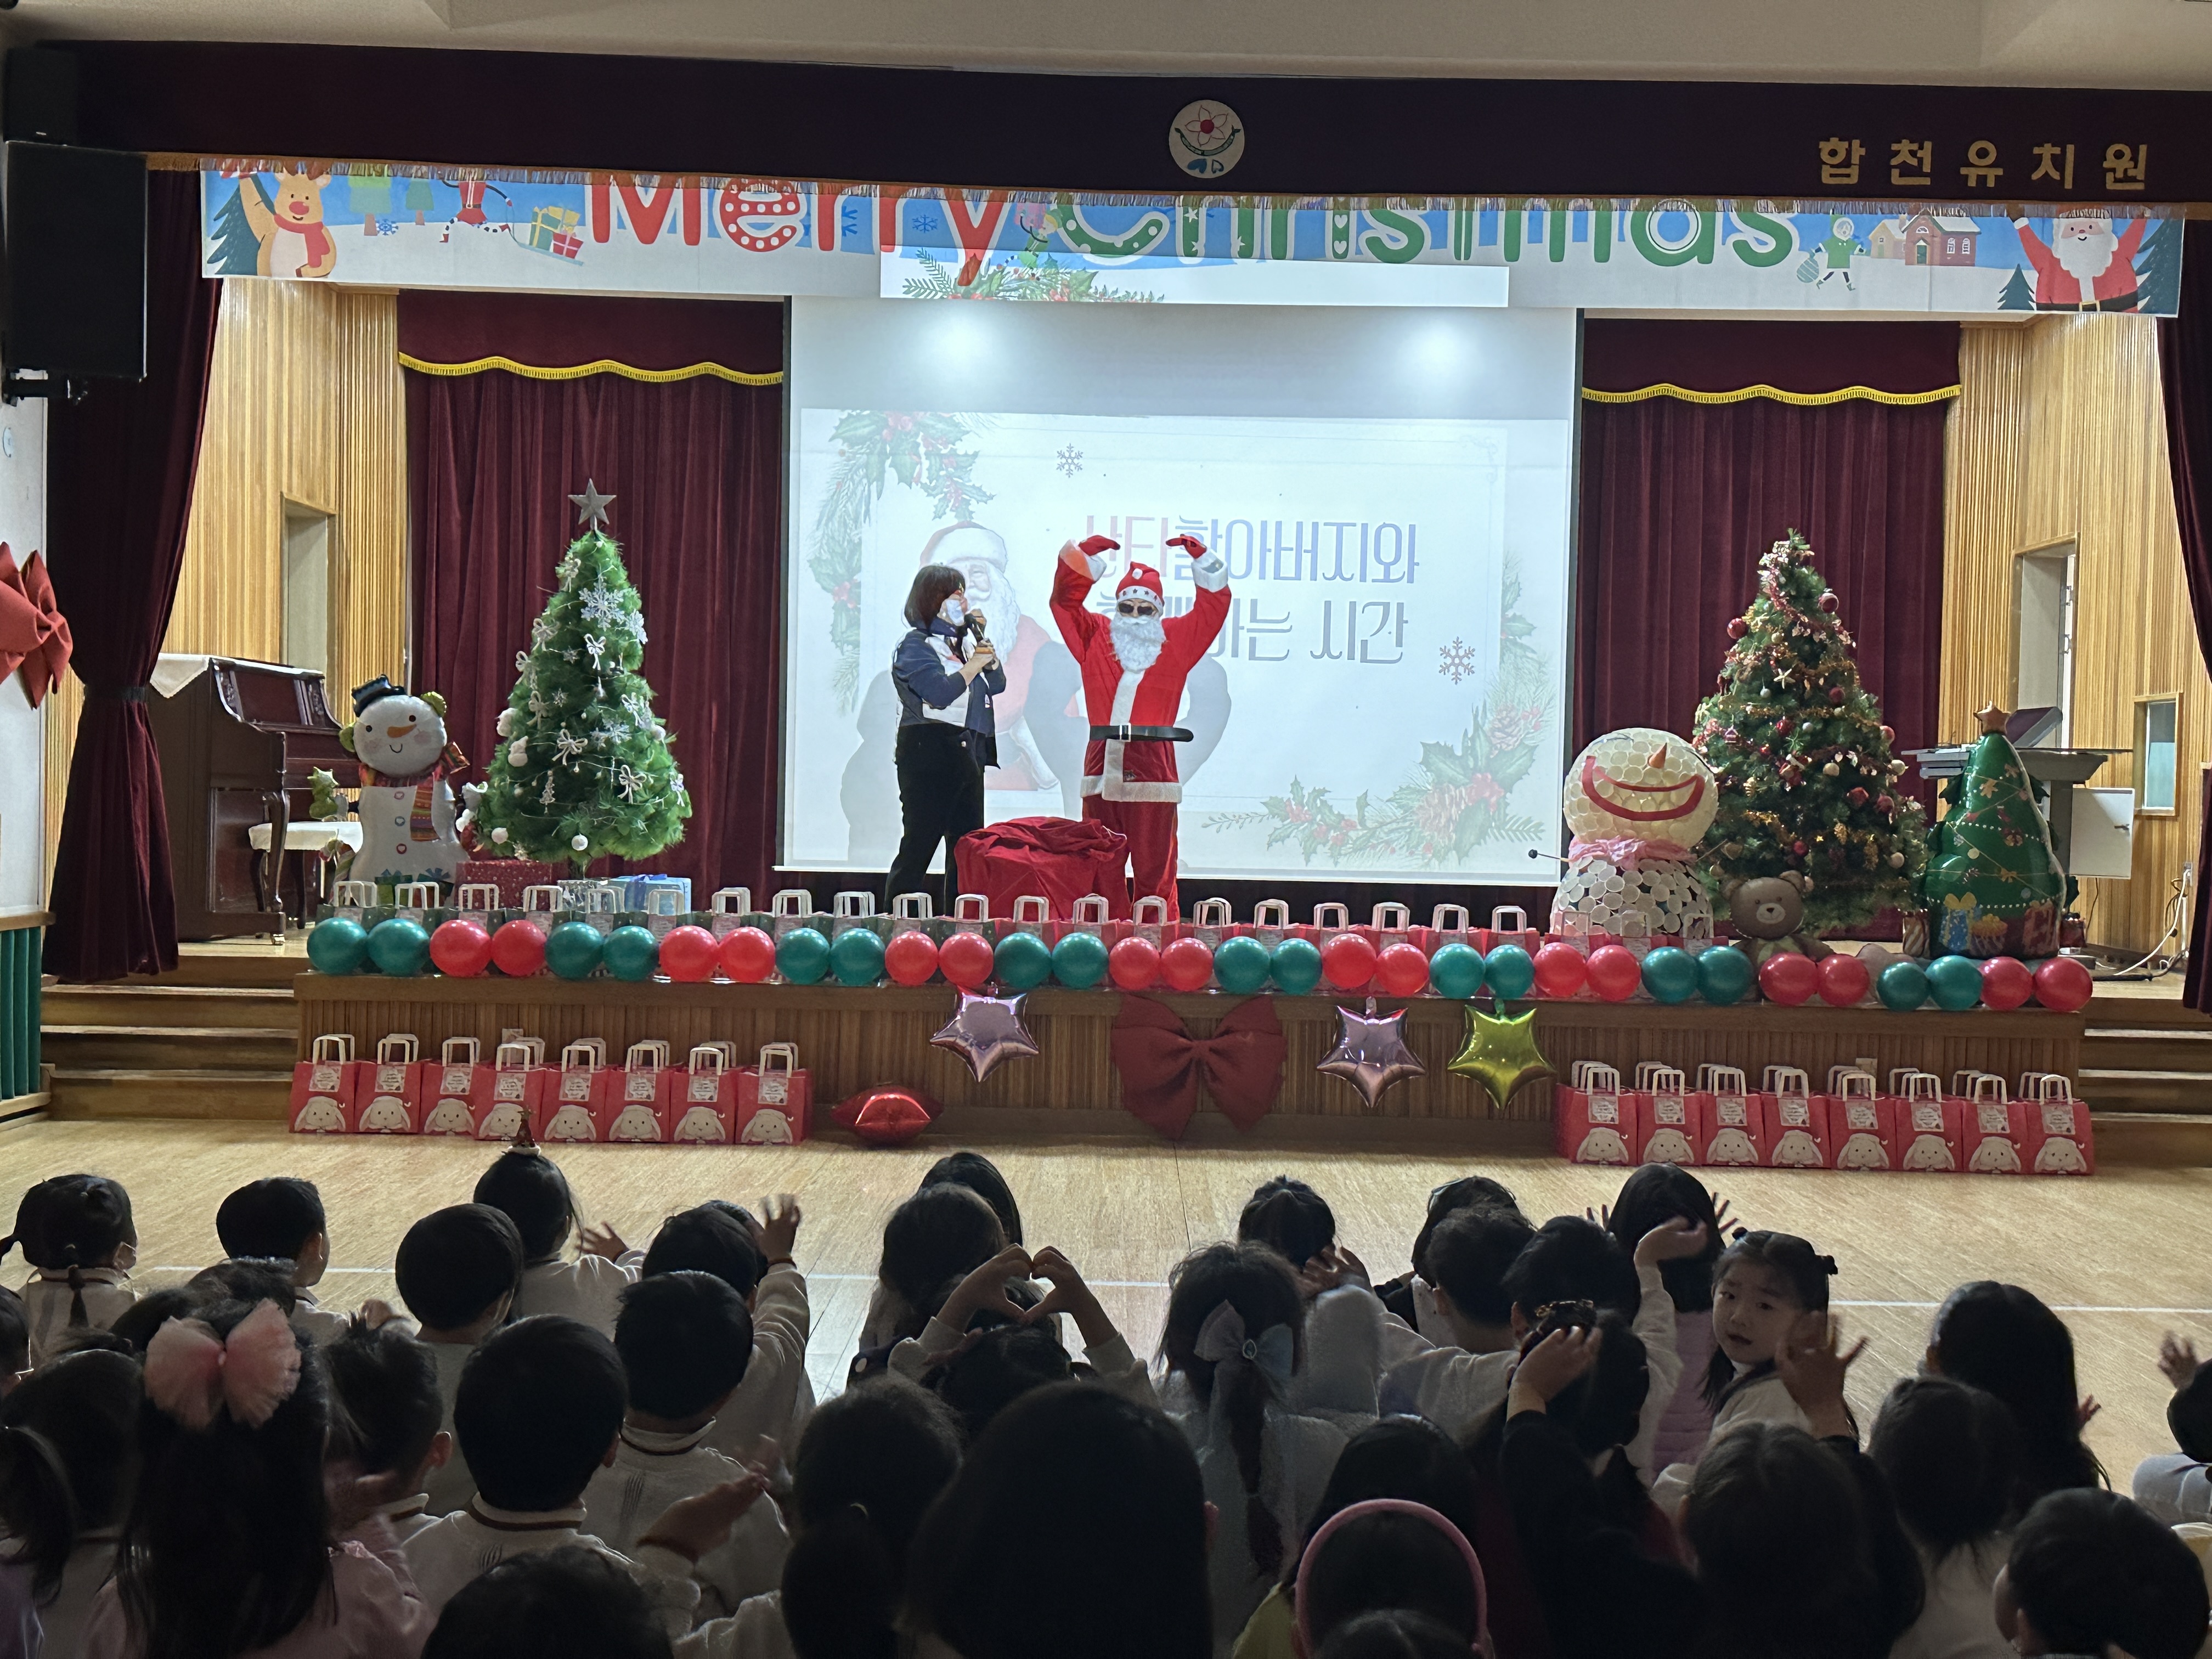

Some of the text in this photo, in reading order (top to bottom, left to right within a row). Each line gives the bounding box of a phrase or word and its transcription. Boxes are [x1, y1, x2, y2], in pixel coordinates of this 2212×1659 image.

[1818, 137, 2148, 190] 합천유치원
[591, 173, 1008, 286] Merry
[1310, 600, 1408, 664] 시간
